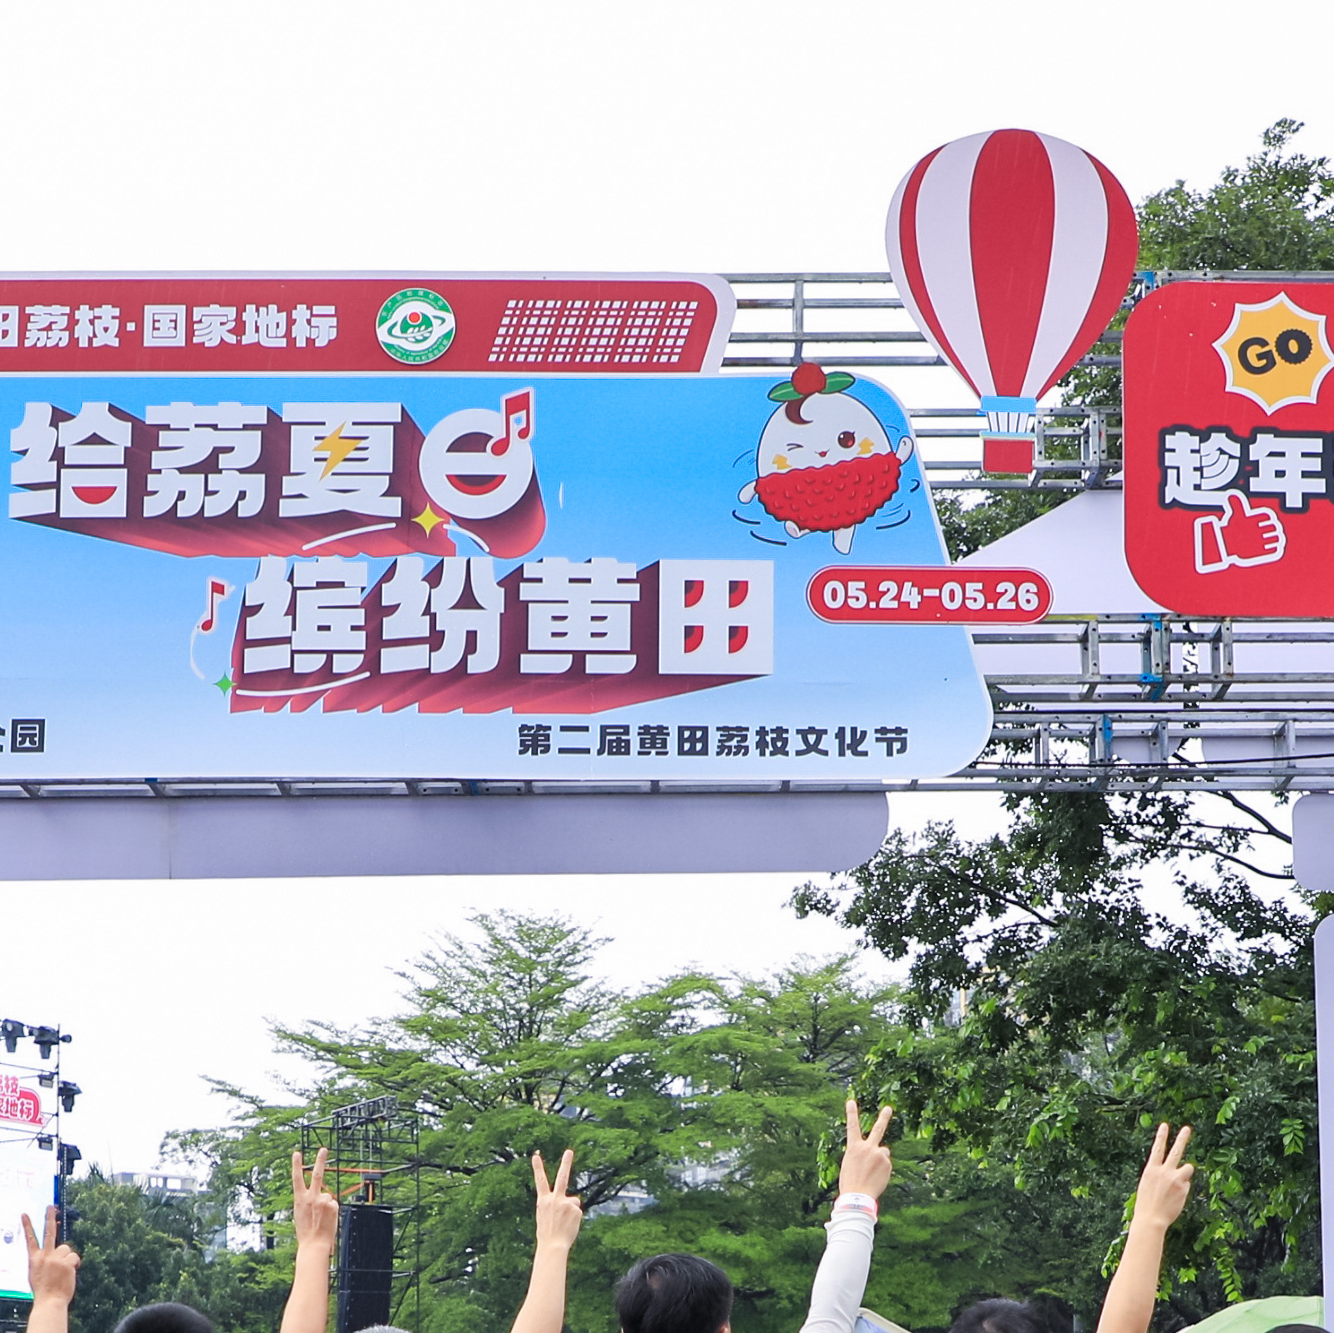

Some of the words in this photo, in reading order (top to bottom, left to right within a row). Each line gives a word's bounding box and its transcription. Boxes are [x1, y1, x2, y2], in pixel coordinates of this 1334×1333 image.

[1236, 328, 1315, 376] GO
[822, 578, 1041, 612] 05.24-05.26
[241, 556, 774, 676] 缤纷黄田
[518, 723, 910, 758] 第二届黄田荔枝文化节
